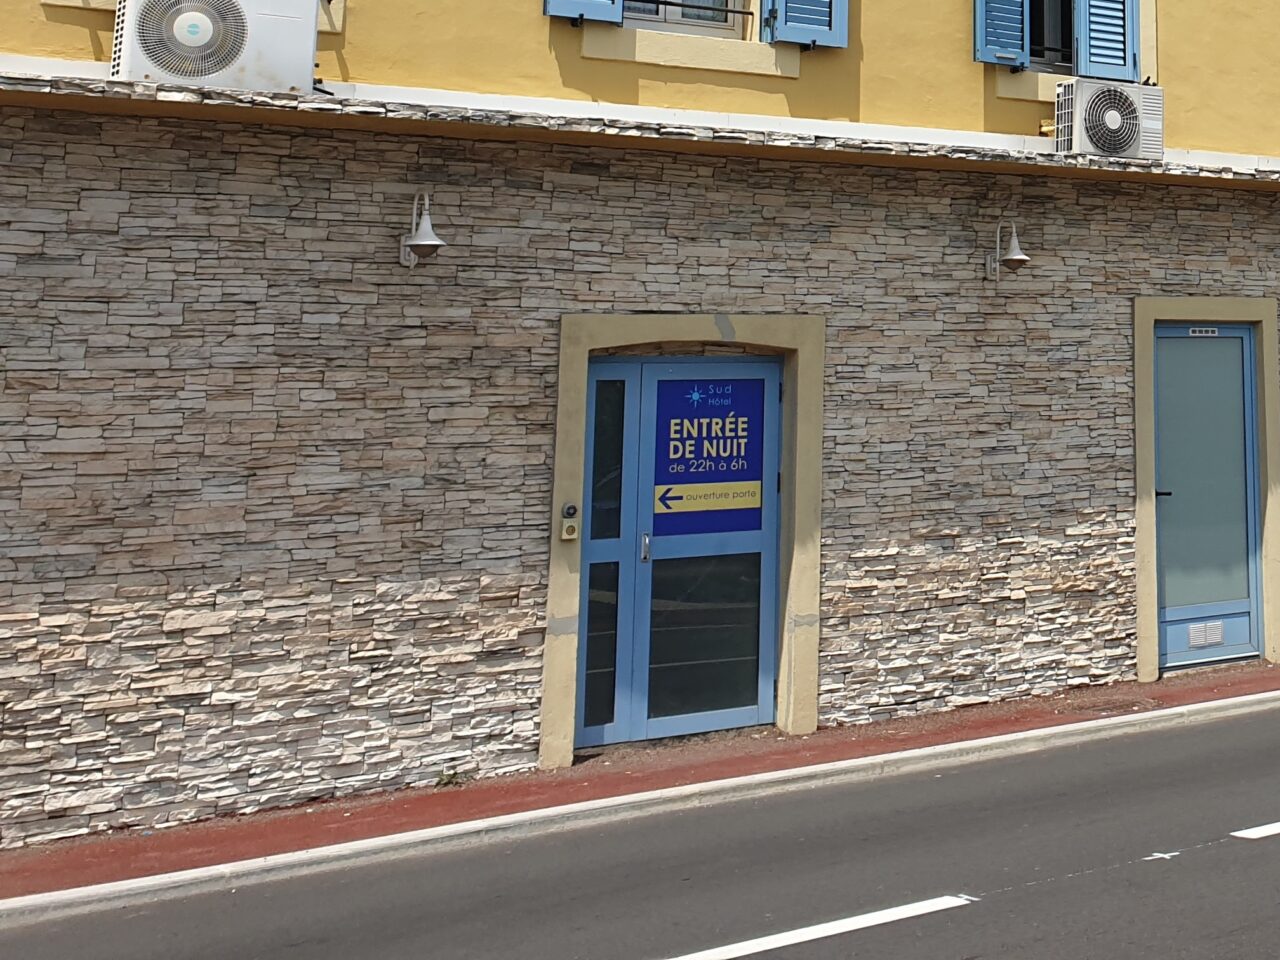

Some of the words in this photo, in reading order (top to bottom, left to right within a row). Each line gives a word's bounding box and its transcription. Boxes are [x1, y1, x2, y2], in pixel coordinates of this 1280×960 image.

[708, 384, 732, 394] Sud
[708, 398, 732, 406] Hôtel
[670, 411, 748, 439] ENTRÉE
[669, 440, 695, 459] DE
[703, 438, 748, 458] NUIT
[668, 462, 686, 473] de
[689, 459, 715, 472] 22h
[718, 460, 727, 471] à
[730, 458, 747, 470] 6h
[686, 490, 730, 501] ouverture
[732, 490, 757, 501] porte
